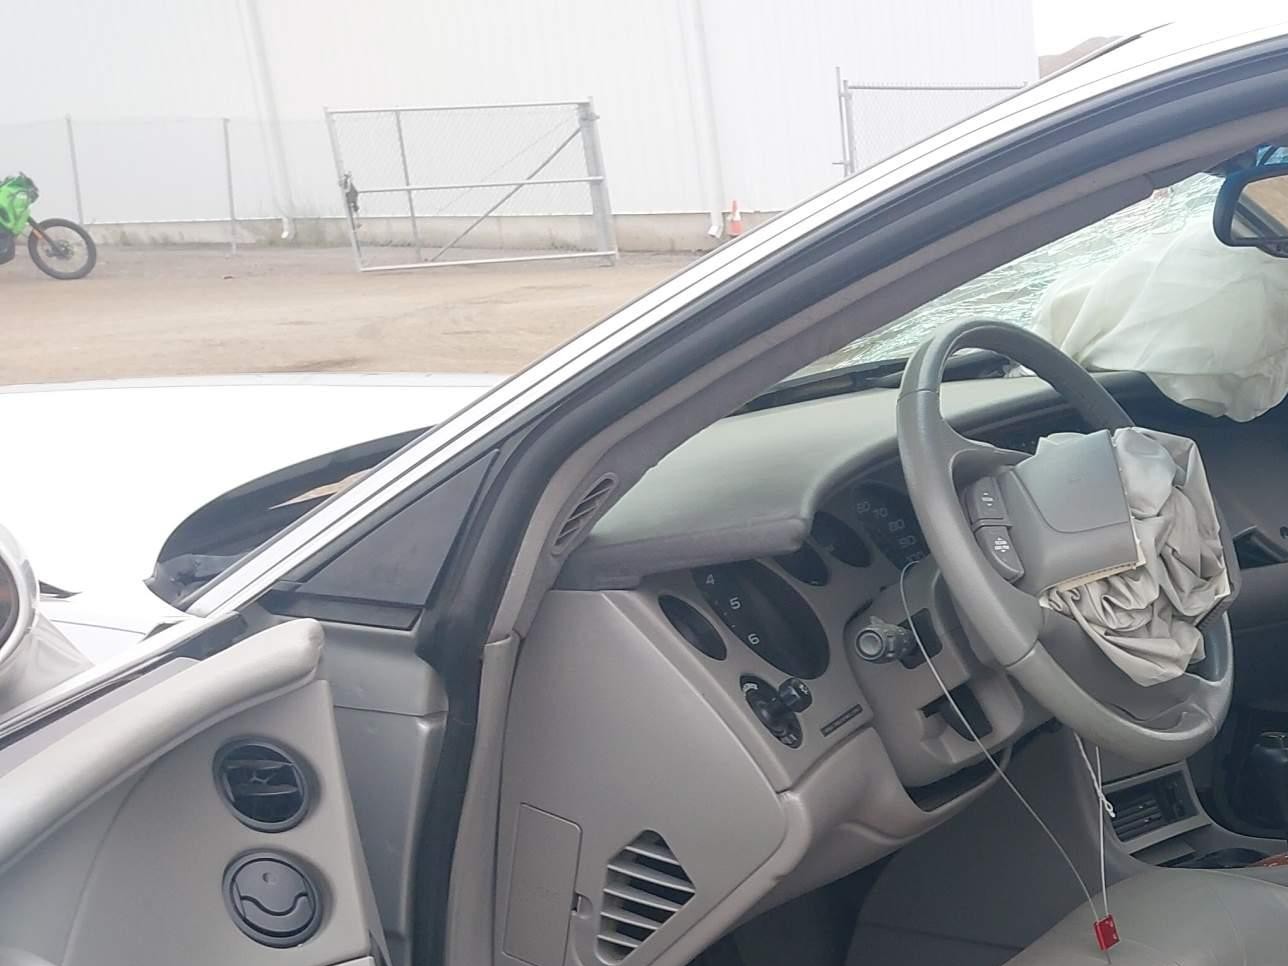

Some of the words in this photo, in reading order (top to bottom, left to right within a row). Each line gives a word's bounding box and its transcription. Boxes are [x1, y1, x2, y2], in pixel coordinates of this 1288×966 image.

[704, 573, 716, 586] 4
[729, 596, 742, 610] 5
[747, 633, 761, 646] 6
